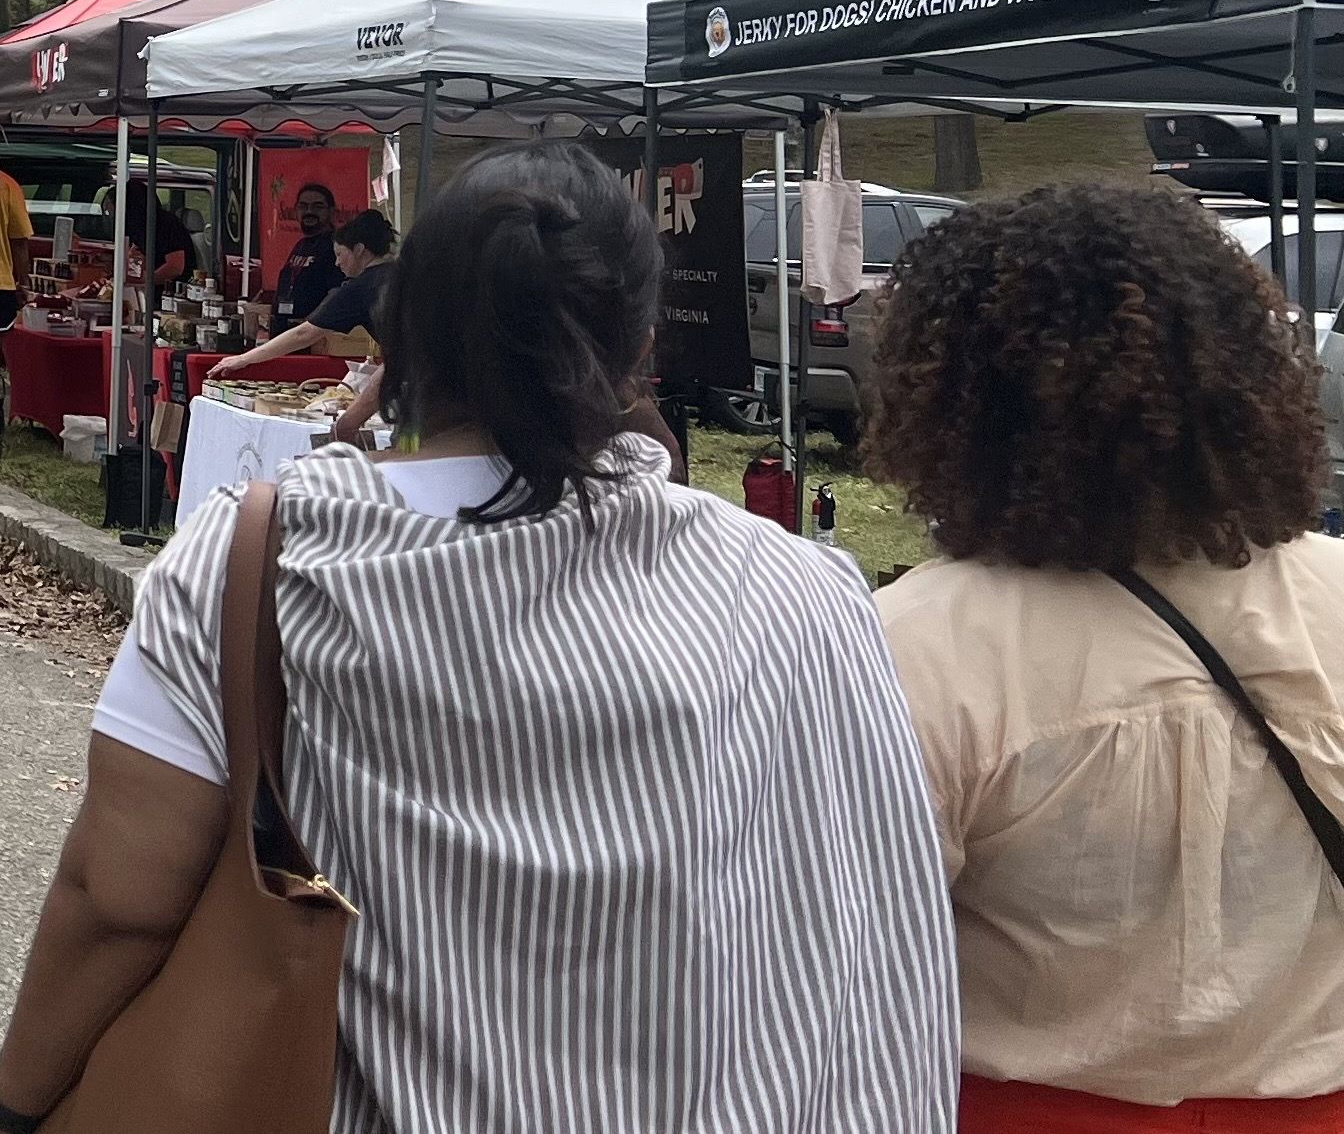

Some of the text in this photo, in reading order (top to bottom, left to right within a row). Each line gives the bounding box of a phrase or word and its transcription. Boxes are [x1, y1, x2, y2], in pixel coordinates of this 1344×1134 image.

[735, 15, 782, 46] JERKY
[784, 11, 818, 39] FOR
[819, 0, 875, 34] DOGS!
[356, 22, 404, 51] VEVOR
[672, 269, 718, 283] SPECIALTY
[665, 306, 710, 325] VIRGINIA
